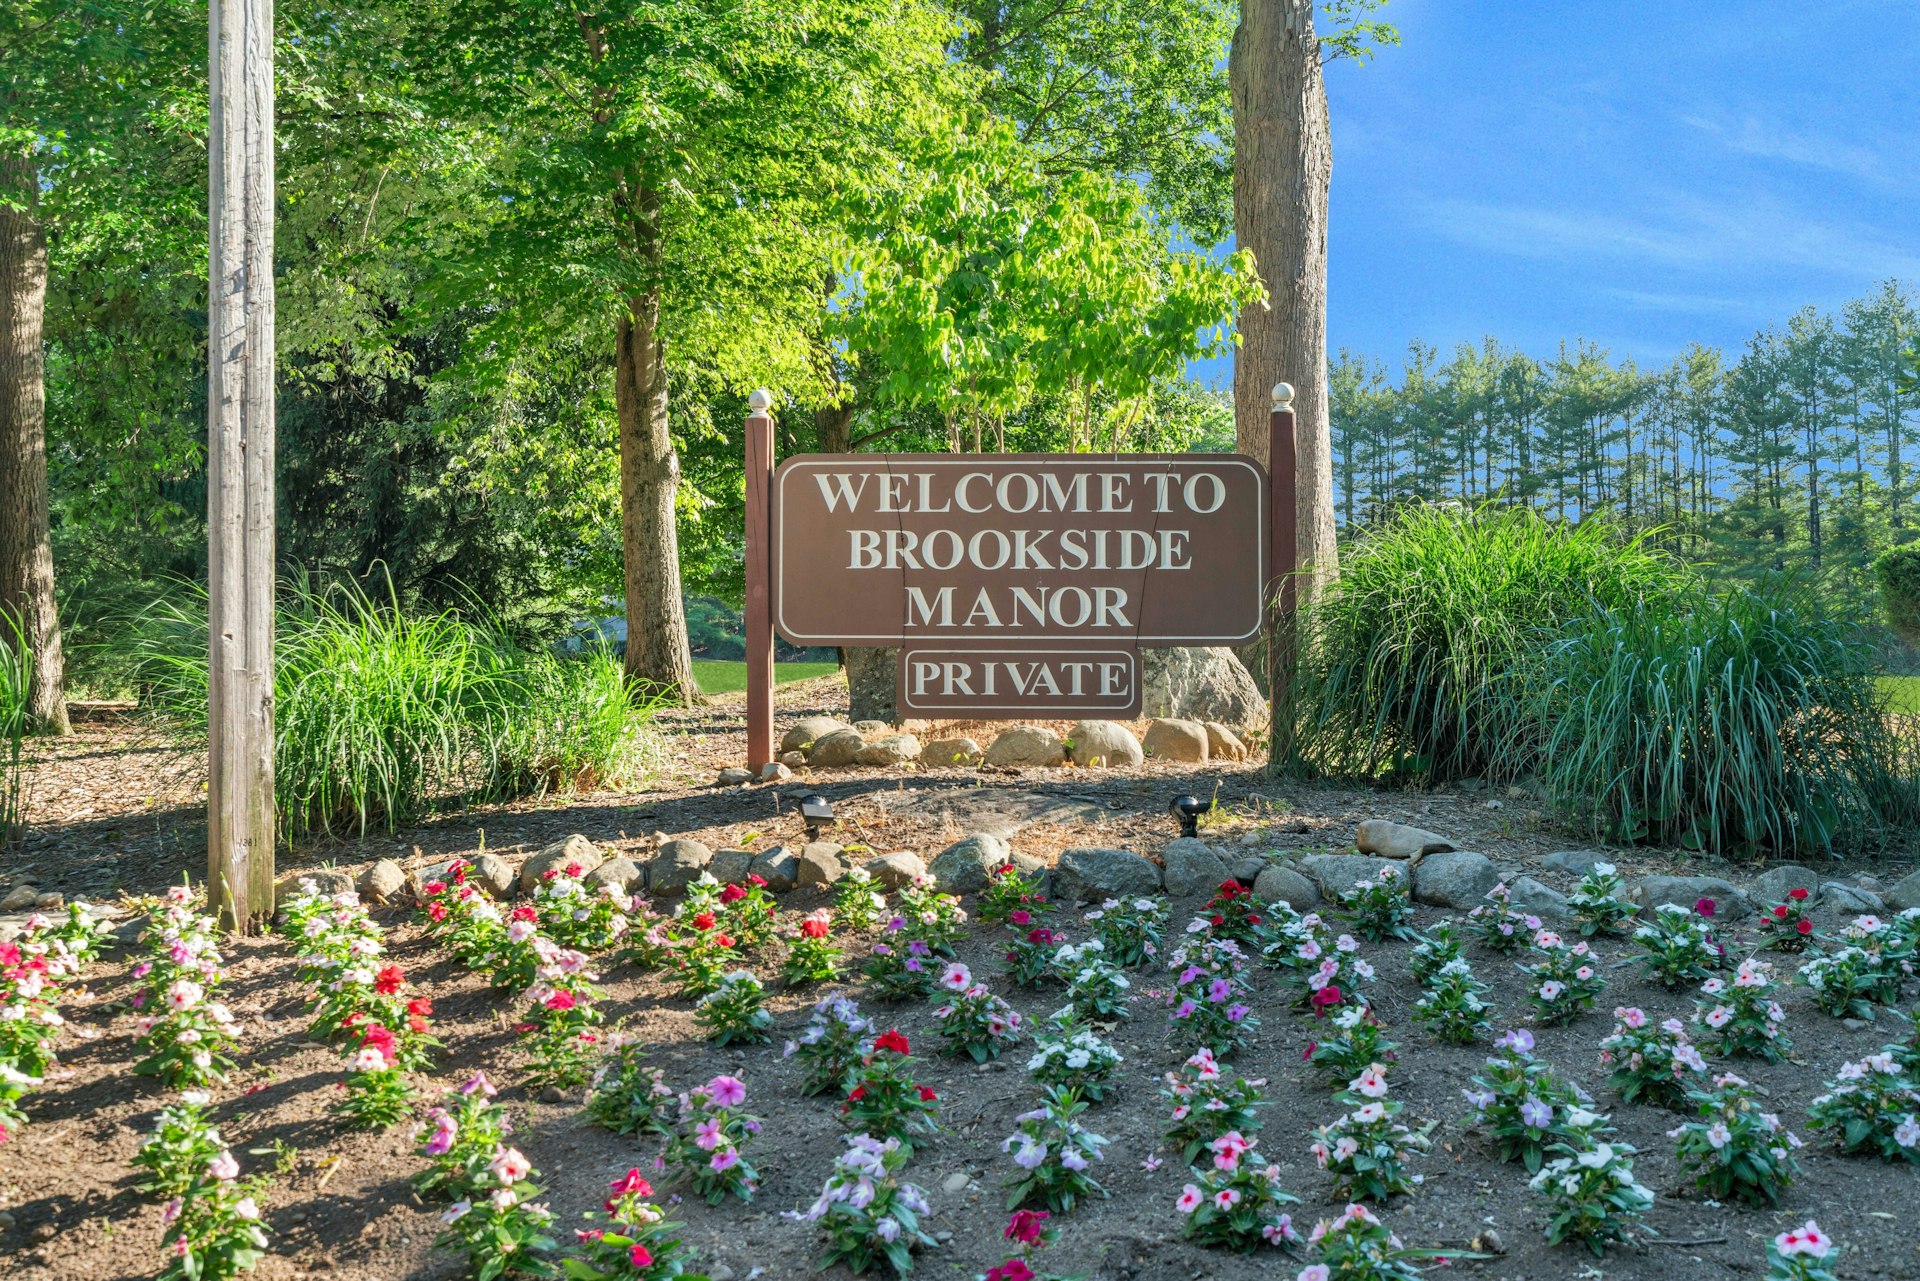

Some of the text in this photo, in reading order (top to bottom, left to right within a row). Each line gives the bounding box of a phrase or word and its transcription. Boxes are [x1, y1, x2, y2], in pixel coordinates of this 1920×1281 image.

[813, 473, 1226, 513] WELCOME TO
[846, 529, 1192, 570] BROOKSIDE
[904, 586, 1134, 628] MANOR
[911, 662, 1129, 696] PRIVATE
